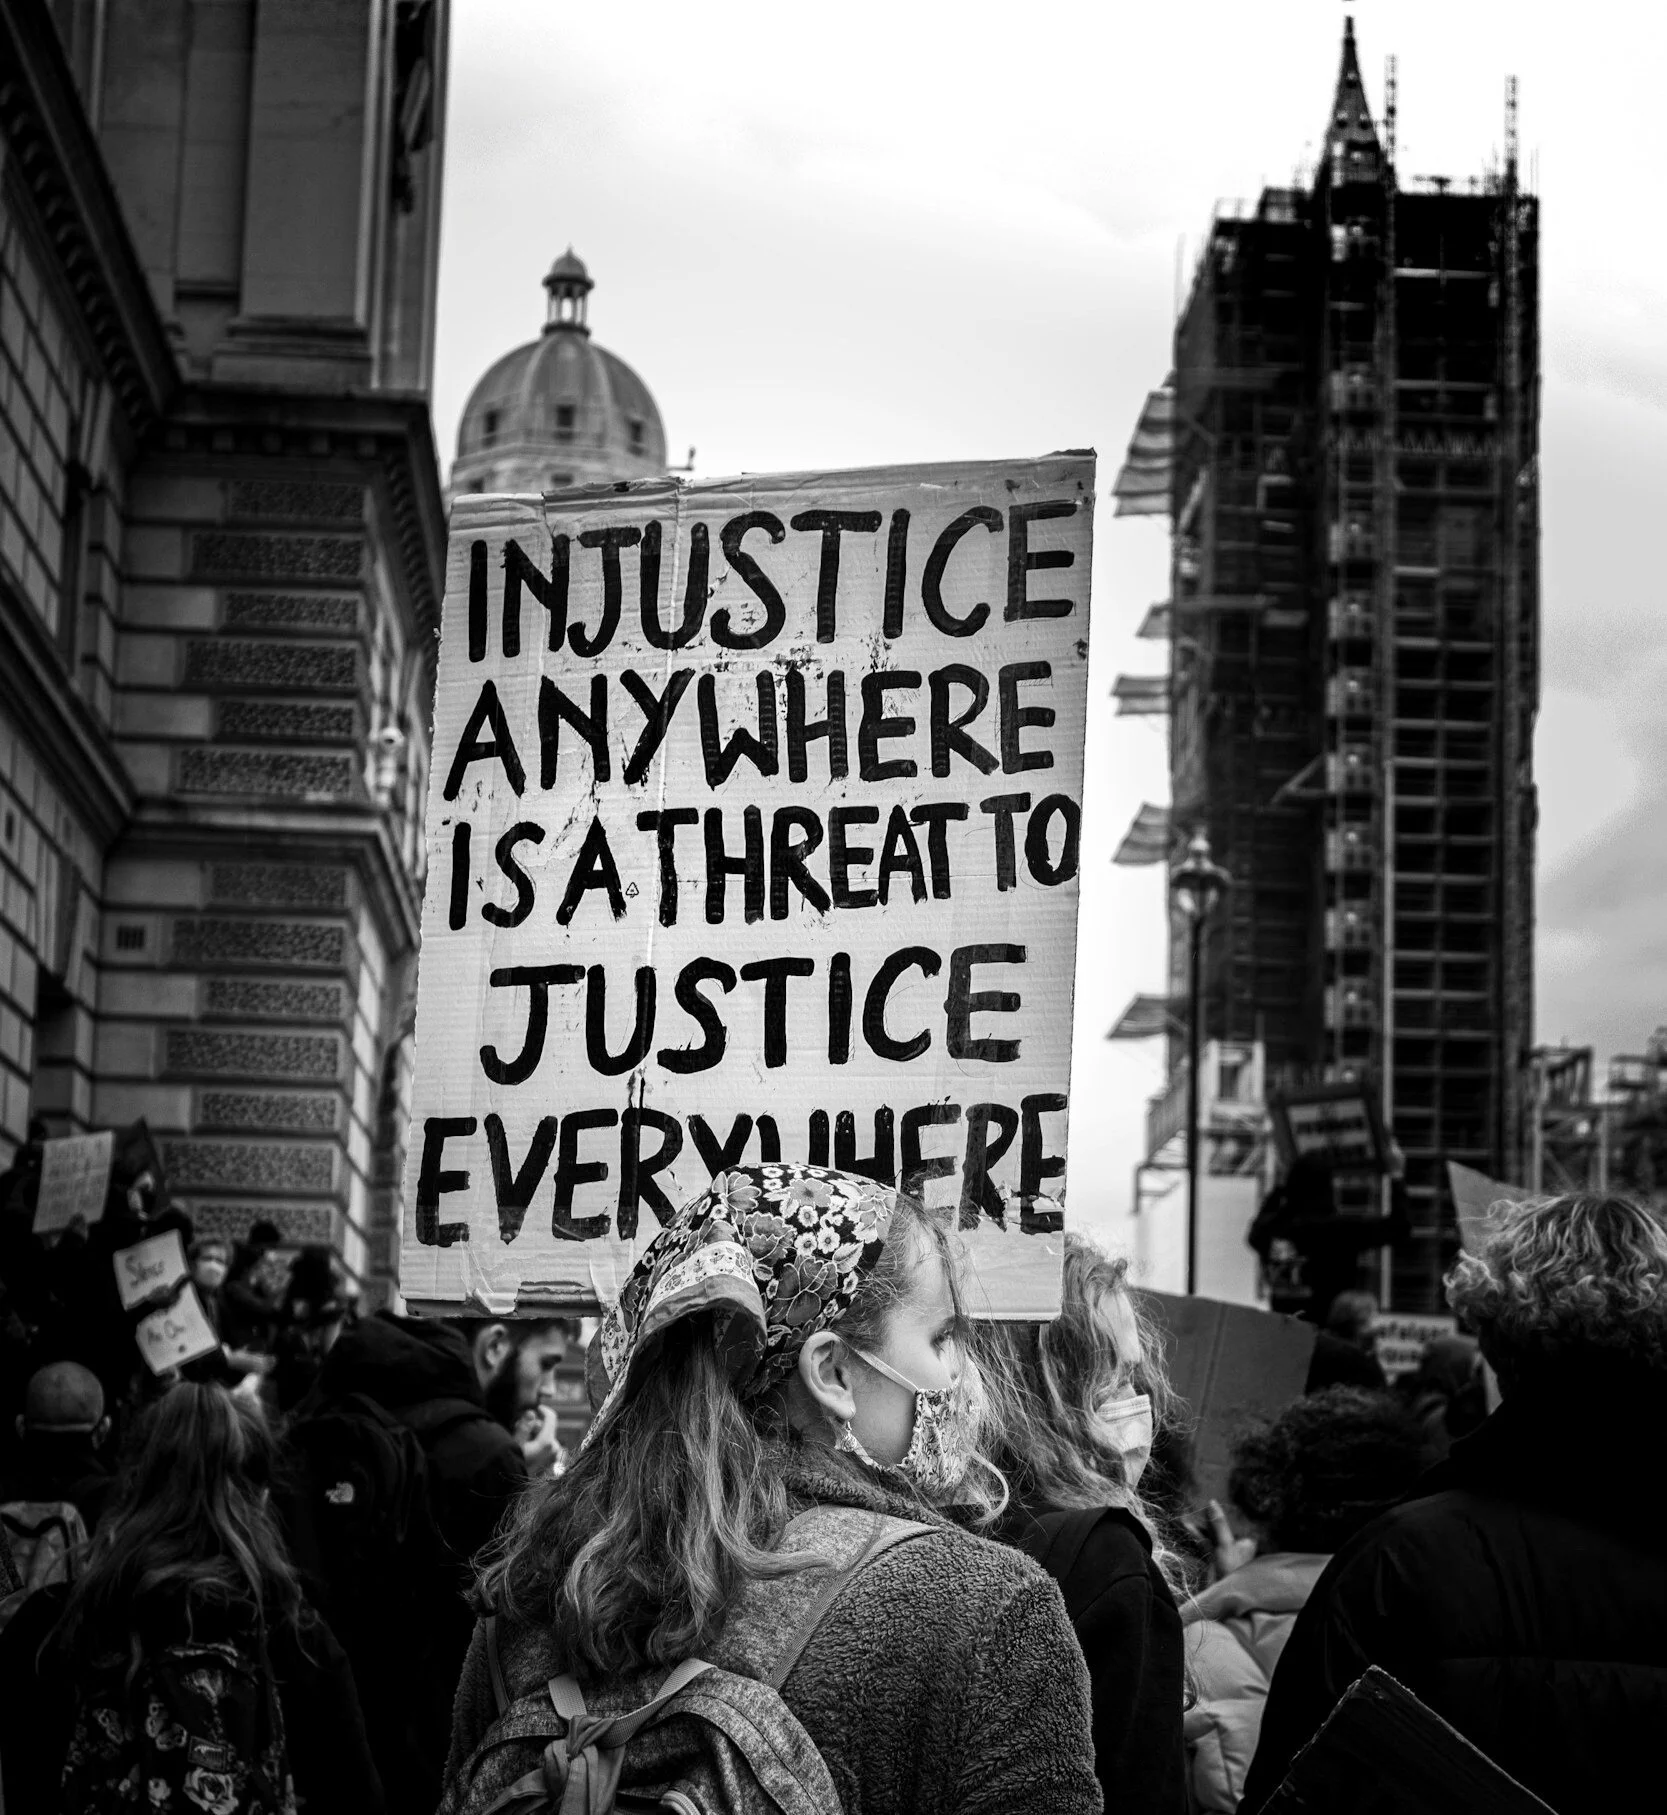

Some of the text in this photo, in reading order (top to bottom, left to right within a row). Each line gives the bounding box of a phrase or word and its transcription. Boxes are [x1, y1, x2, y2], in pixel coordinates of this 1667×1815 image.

[469, 500, 1078, 662] INJUSTICE
[443, 661, 1055, 801] ANYWHERE
[449, 792, 1079, 930] IS A THREAT TO
[479, 943, 1026, 1085] JUSTICE
